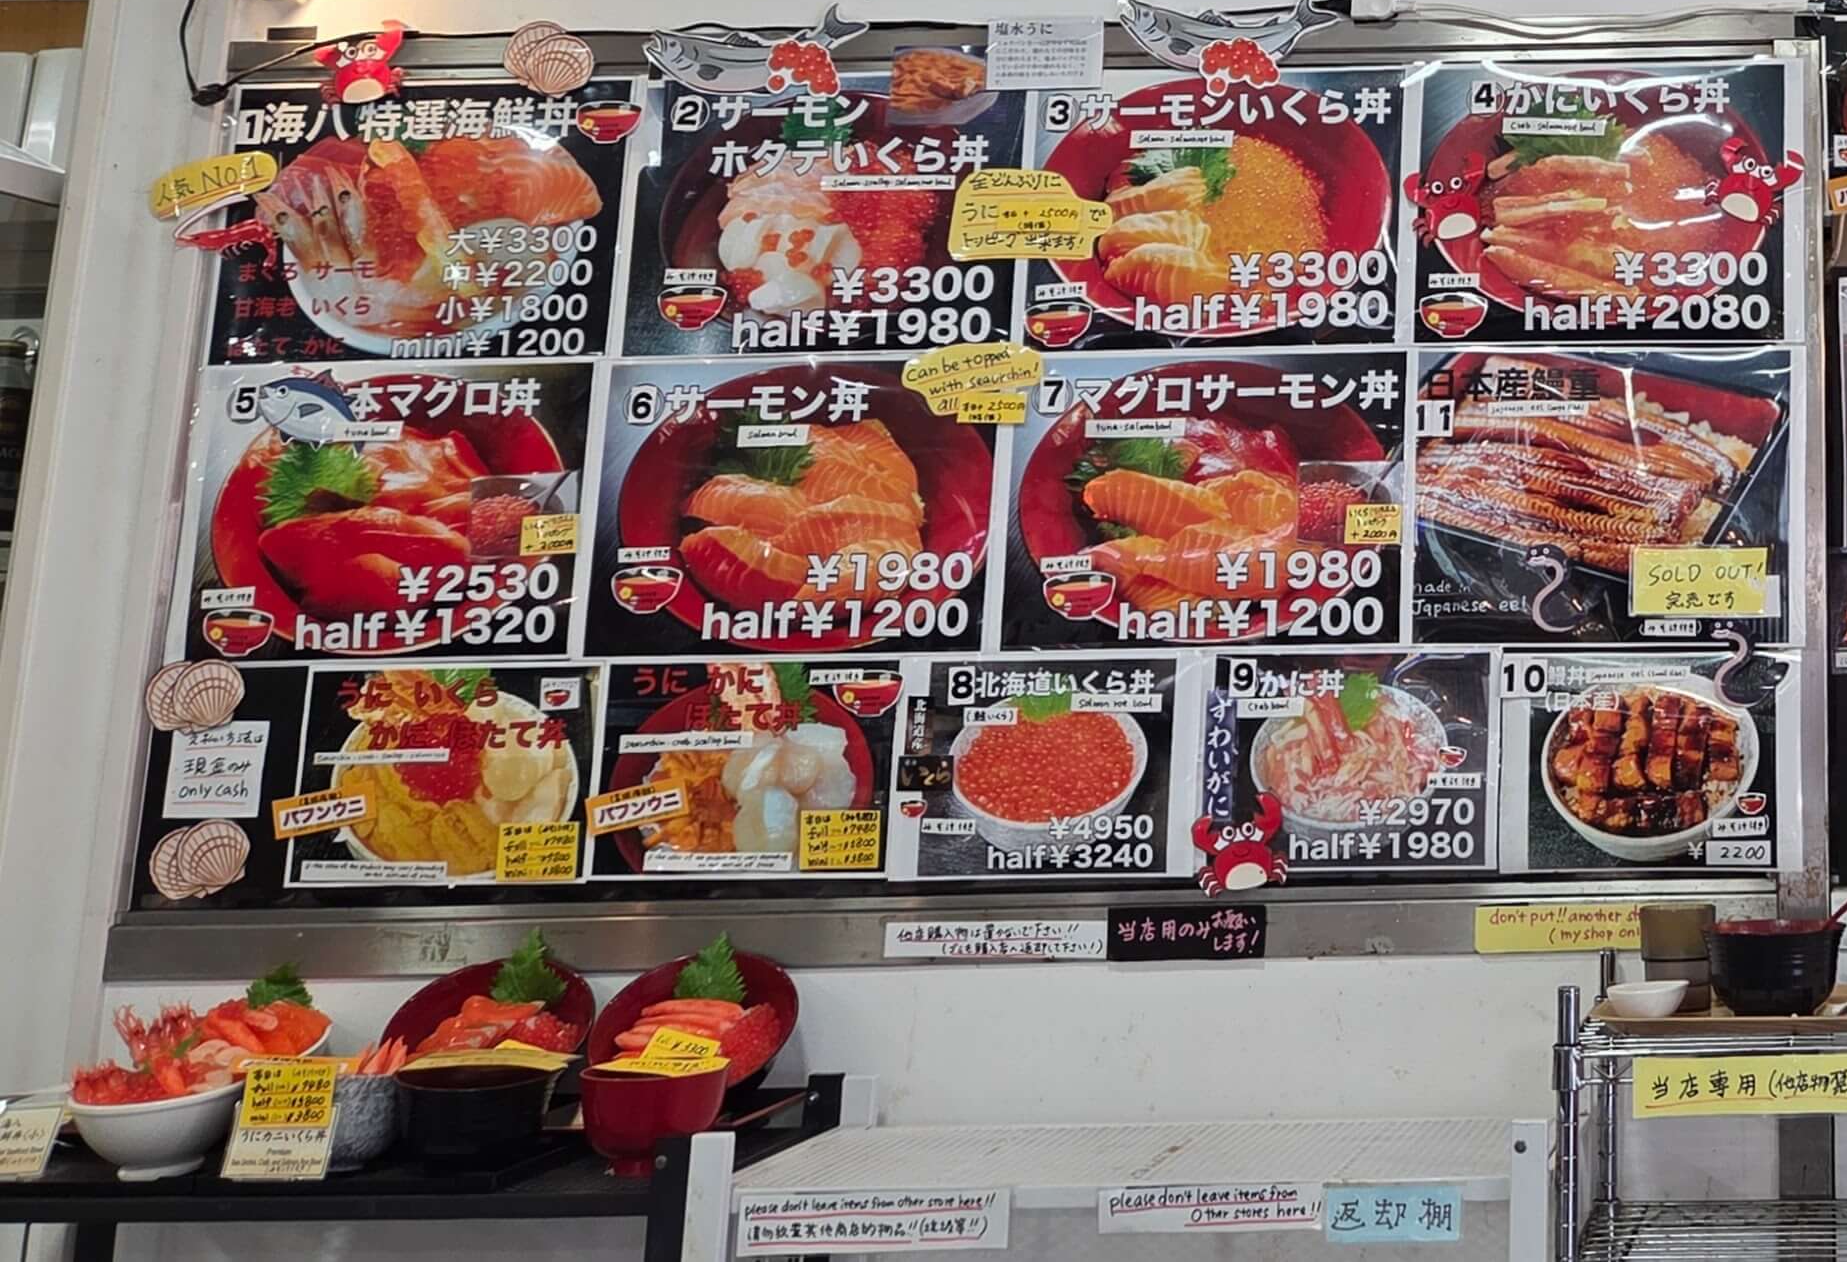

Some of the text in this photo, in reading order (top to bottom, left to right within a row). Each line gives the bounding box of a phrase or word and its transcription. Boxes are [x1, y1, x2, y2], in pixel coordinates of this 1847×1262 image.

[1081, 87, 1392, 130] サーモンいくら丼
[1505, 79, 1730, 114] かにいくら丼
[263, 96, 578, 143] 海八特選海鮮丼
[713, 96, 869, 131] サーモン
[709, 134, 989, 177] ホタテいくら丼
[156, 177, 195, 208] 人気
[970, 171, 1061, 189] 全どんぶりに
[962, 203, 998, 221] うに
[833, 265, 994, 303] ¥3300
[1229, 251, 1387, 287] ¥3300
[1613, 252, 1767, 286] ¥3300
[310, 296, 371, 315] いくら
[435, 293, 588, 325] 小¥1800
[1135, 292, 1389, 331] half¥1980
[1523, 294, 1770, 330] half¥2080
[732, 308, 991, 348] half¥1980
[302, 337, 344, 355] かに
[390, 328, 586, 359] mini¥1200
[942, 357, 959, 373] be
[347, 378, 541, 418] 本マグロ丼
[929, 380, 963, 395] with
[1075, 370, 1399, 414] マグロサーモン丼
[1427, 367, 1598, 400] 日本産鰻重
[665, 382, 869, 423] サーモン丼
[937, 398, 958, 411] all
[398, 563, 559, 602] ¥2530
[807, 553, 972, 592] ¥1980
[1216, 550, 1382, 590] ¥1980
[1649, 562, 1764, 586] SOLD OUT!
[1666, 592, 1735, 609] 完売です
[294, 607, 554, 650] half¥1320
[702, 599, 968, 639] half¥1200
[1118, 598, 1384, 639] half¥1200
[415, 680, 497, 707] いくら
[634, 667, 763, 695] うに かに
[975, 670, 1155, 697] 北海道いくら丼
[1259, 669, 1344, 698] かに丼
[1503, 664, 1545, 693] 10
[1546, 691, 1619, 711] (日本産)
[686, 703, 798, 731] ほたて丼
[179, 779, 248, 798] only cash
[599, 792, 679, 822] バフンウニ
[1358, 798, 1475, 826] ¥2970
[1050, 815, 1153, 839] ¥4950
[987, 844, 1153, 870] half¥3240
[1289, 831, 1474, 860] half¥1980
[1720, 848, 1765, 859] 2200
[1568, 909, 1621, 922] another
[1118, 920, 1210, 942] 当店用のみ
[1582, 925, 1613, 940] shop
[1652, 1070, 1757, 1100] 当店専用
[1234, 1203, 1306, 1219] stores here
[1331, 1198, 1452, 1231] 返却棚
